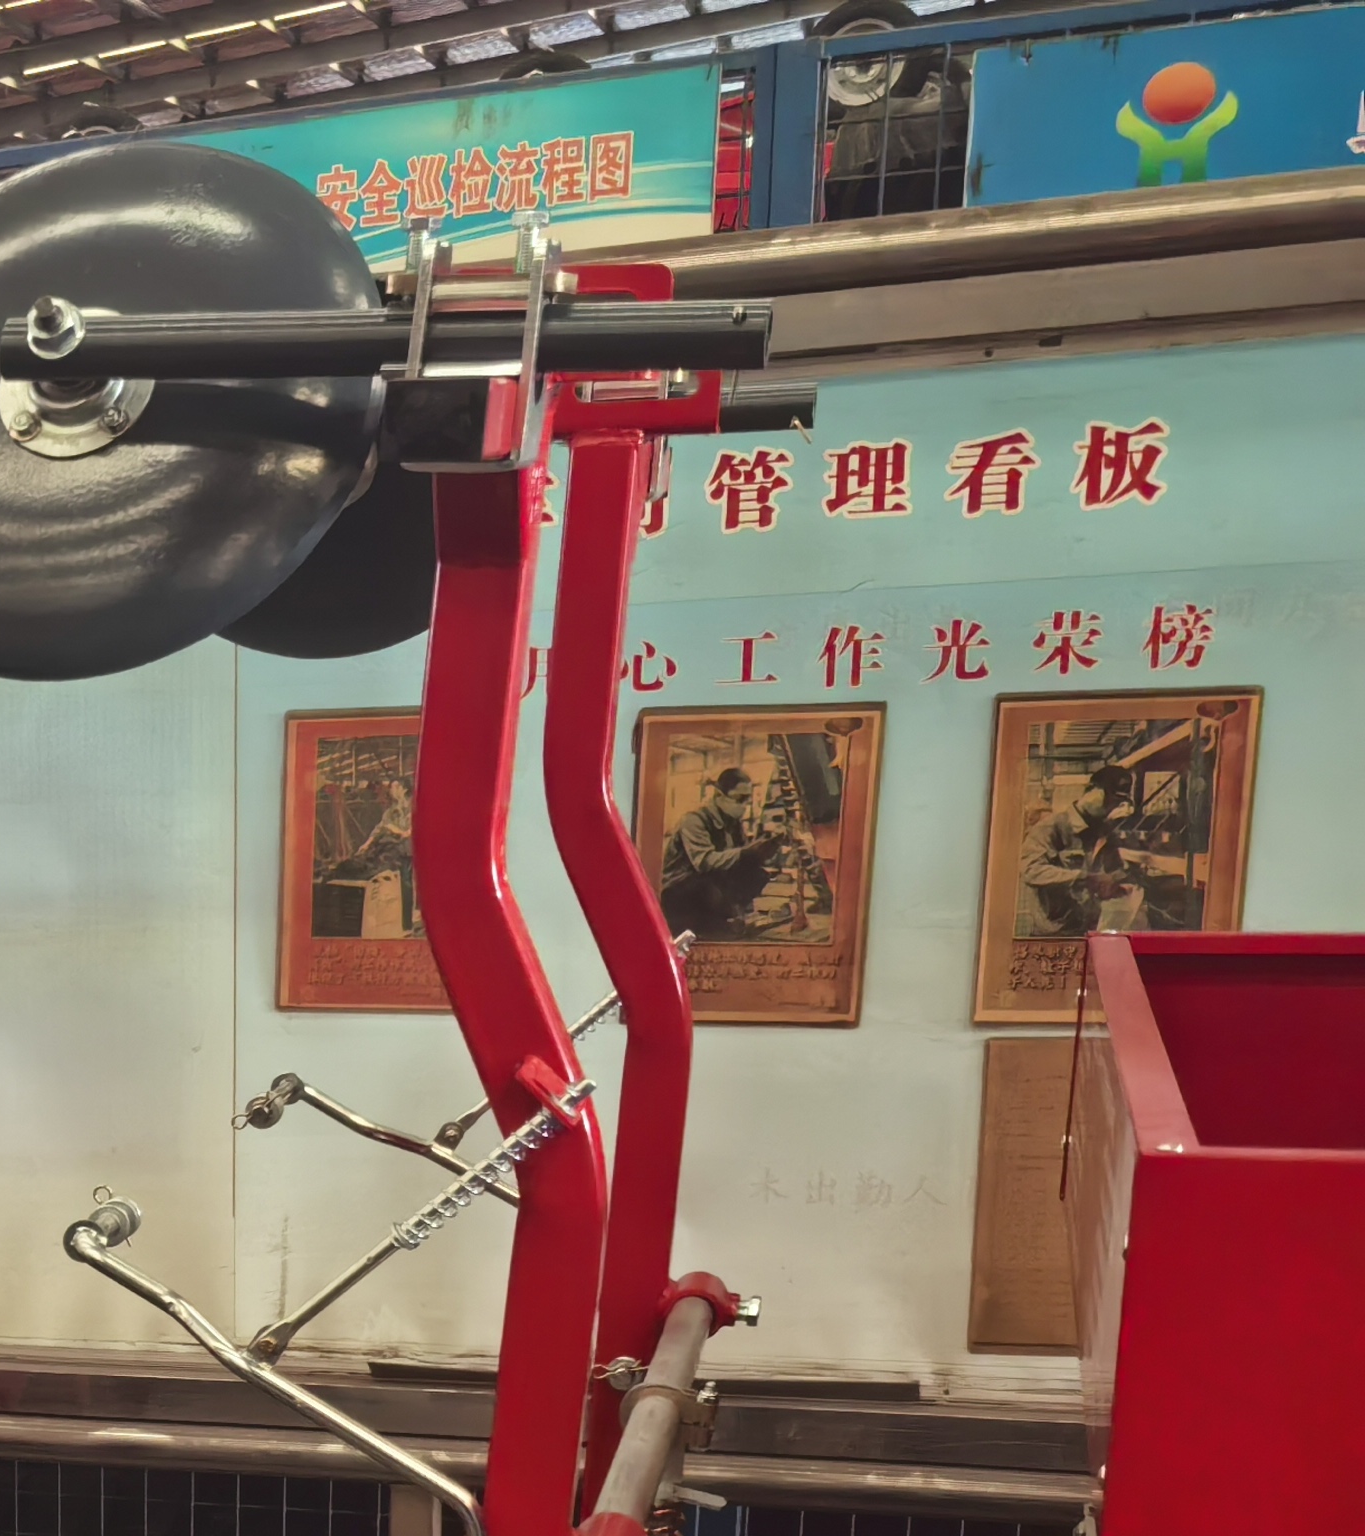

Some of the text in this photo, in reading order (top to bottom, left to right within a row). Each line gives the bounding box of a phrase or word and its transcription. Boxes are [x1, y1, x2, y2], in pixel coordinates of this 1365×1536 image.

[316, 130, 634, 231] 安全巡检流程图
[535, 416, 1171, 540] 管理看板
